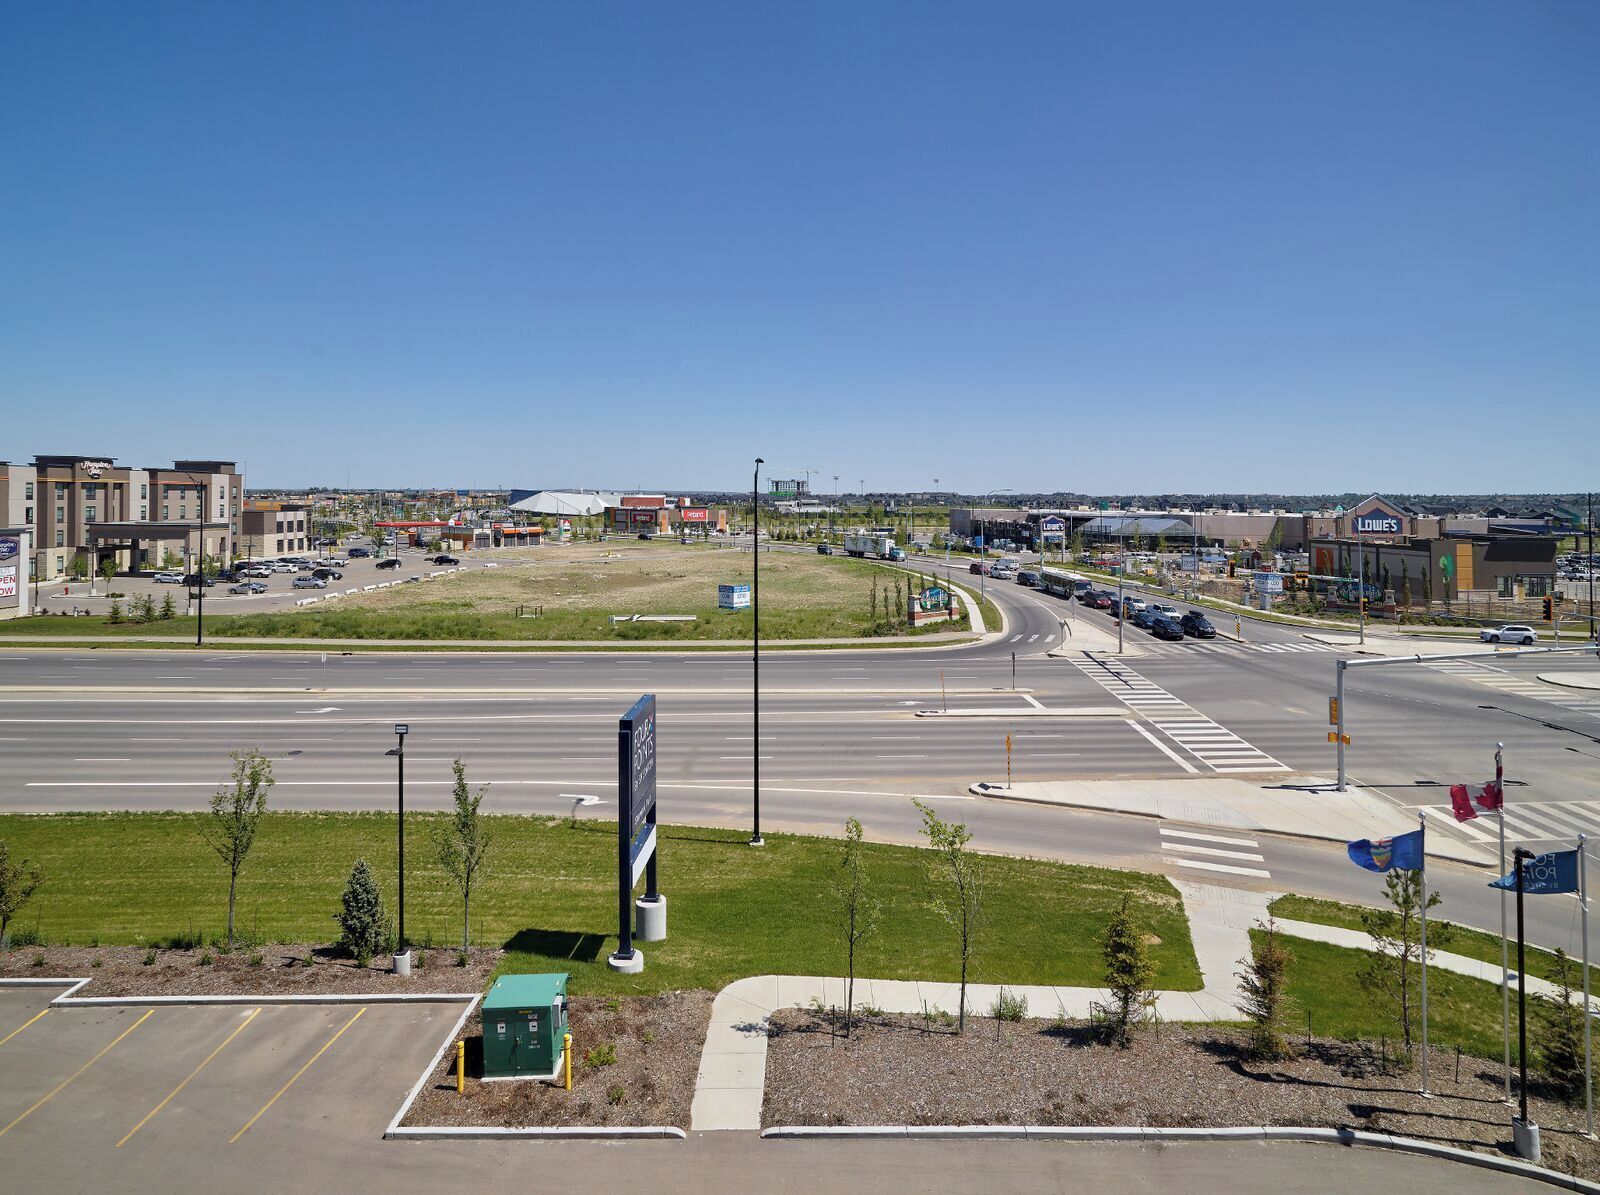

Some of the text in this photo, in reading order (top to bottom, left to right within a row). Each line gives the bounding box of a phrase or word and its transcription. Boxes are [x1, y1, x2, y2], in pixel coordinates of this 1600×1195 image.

[1043, 522, 1065, 531] LOWE'S
[1358, 517, 1398, 532] LOWE'S
[0, 587, 14, 596] OW
